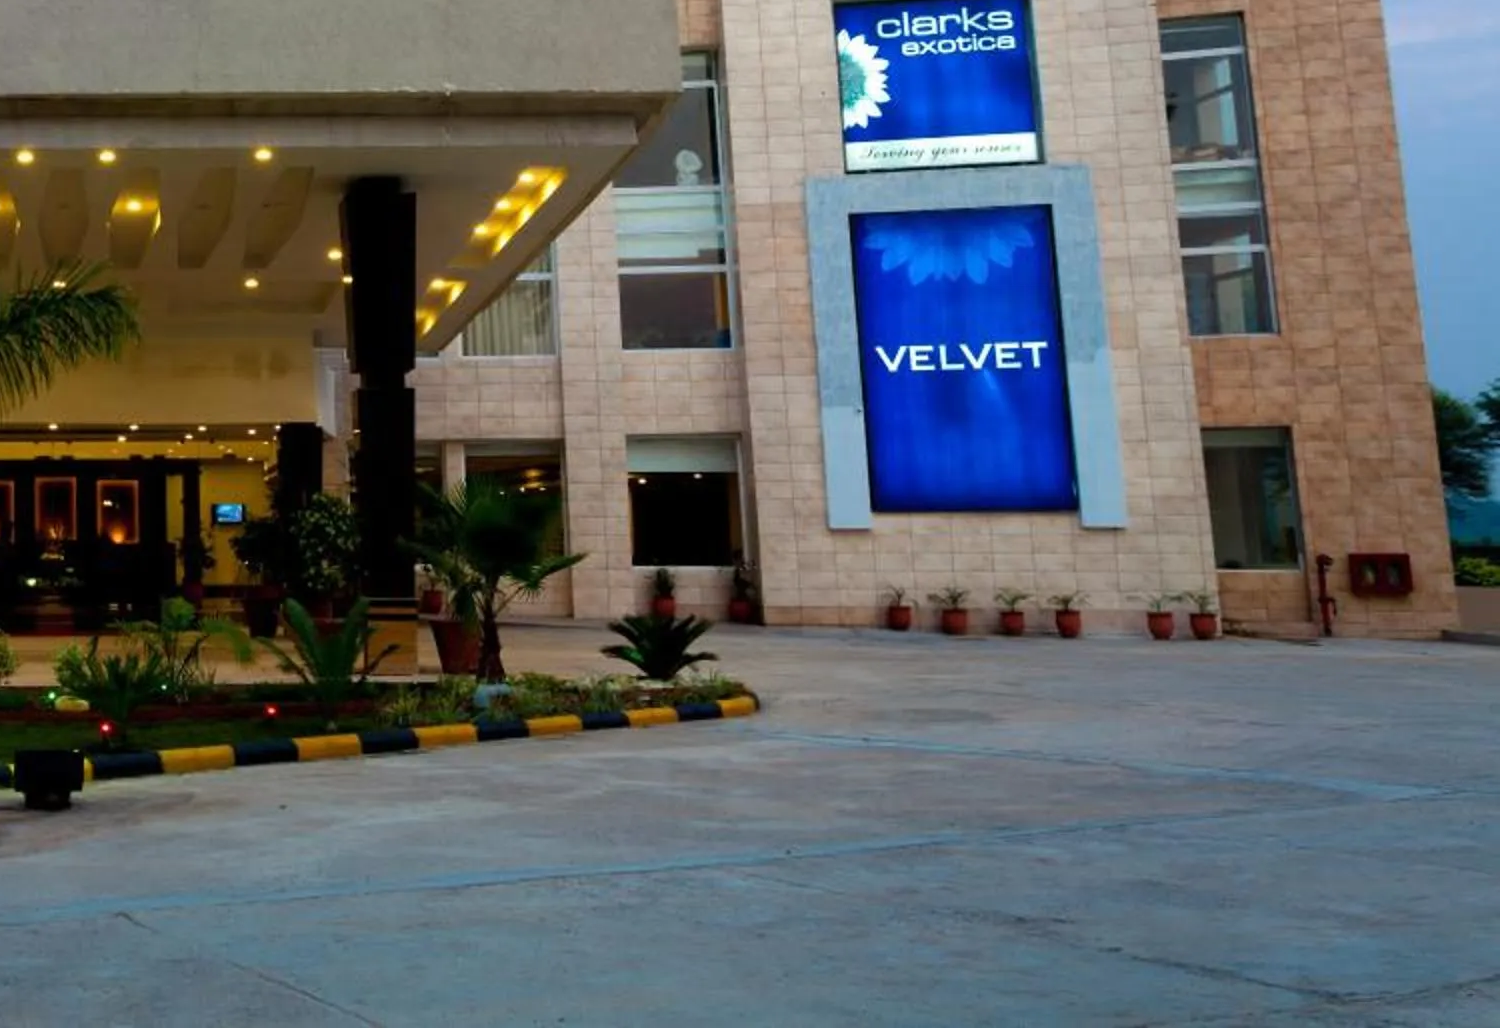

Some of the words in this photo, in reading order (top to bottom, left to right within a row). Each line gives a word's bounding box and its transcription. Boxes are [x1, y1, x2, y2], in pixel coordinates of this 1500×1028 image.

[877, 7, 1014, 39] clarks
[902, 34, 1016, 56] exotica
[875, 341, 1048, 372] VELVET
